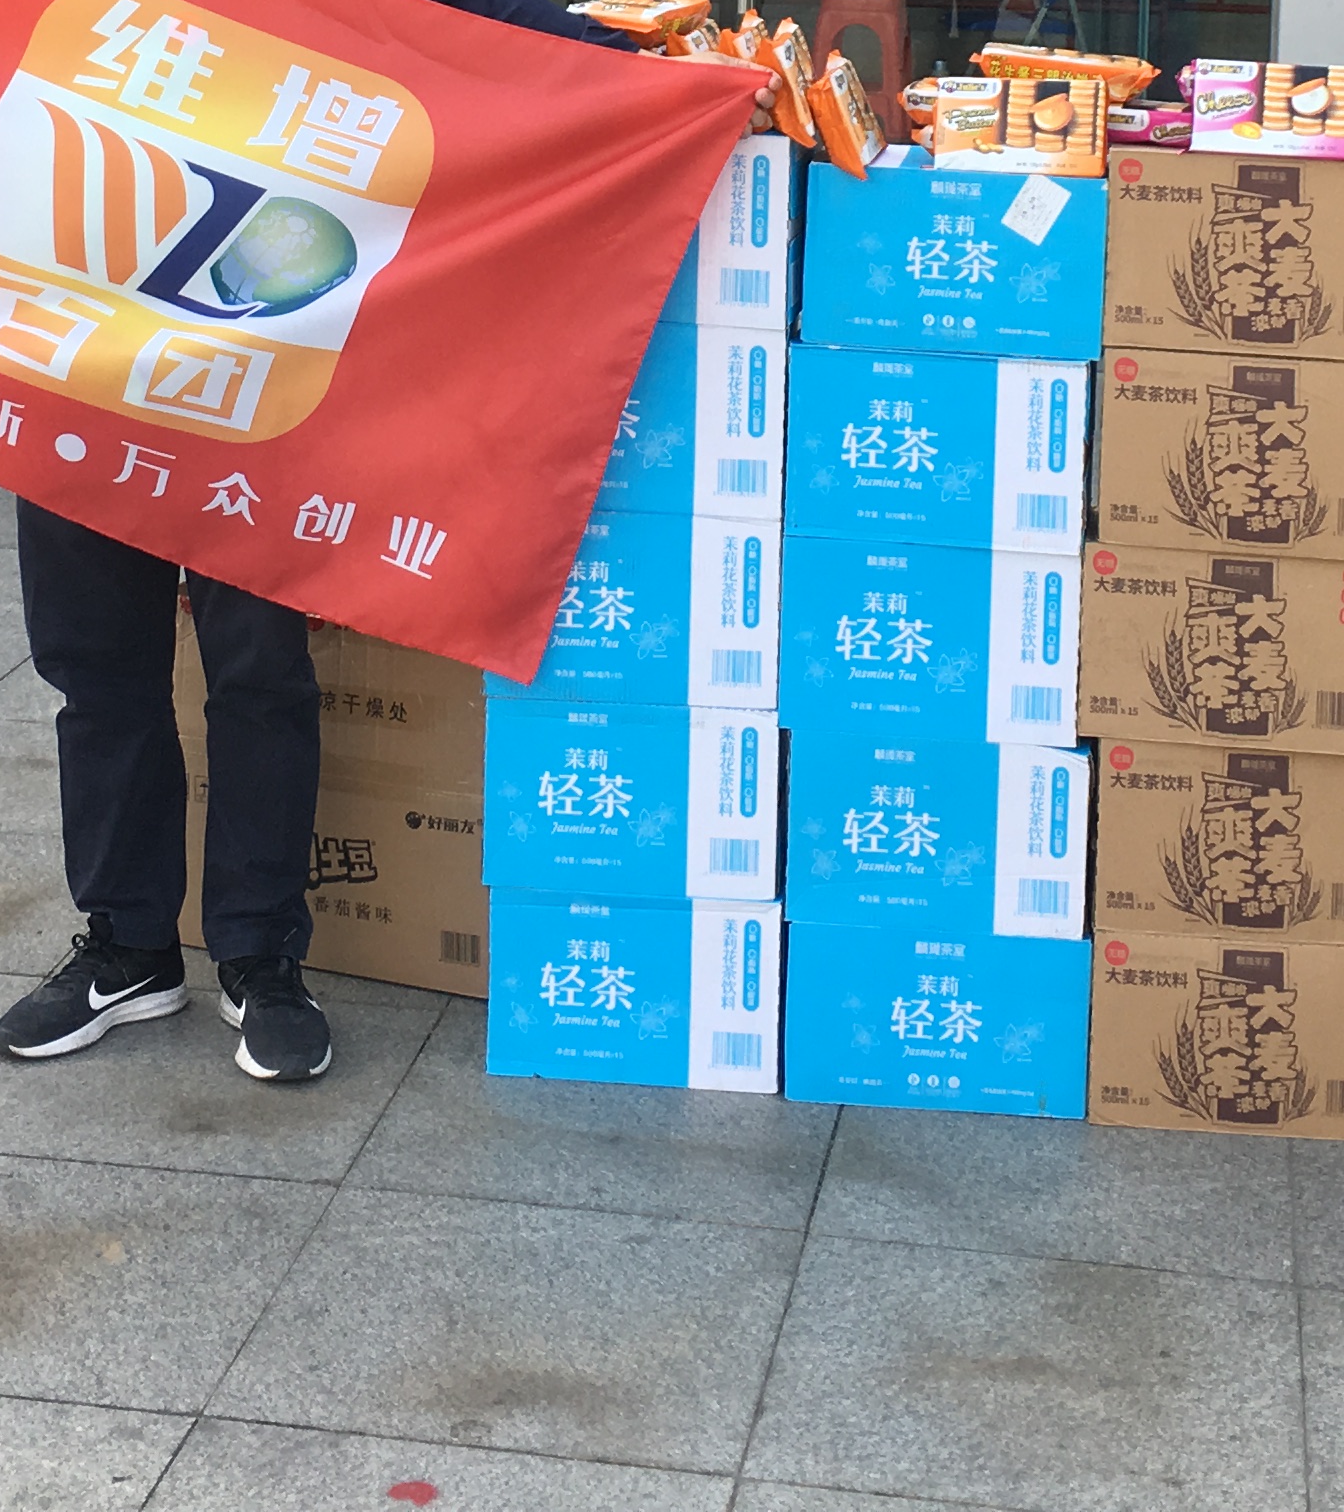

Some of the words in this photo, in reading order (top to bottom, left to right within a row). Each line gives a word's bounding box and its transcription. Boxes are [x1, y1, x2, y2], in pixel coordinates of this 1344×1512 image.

[1196, 89, 1254, 115] Cheese
[728, 153, 747, 248] 茉莉花茶饮料
[1119, 184, 1203, 204] 大麦茶饮料
[932, 214, 975, 236] 茉莉
[906, 236, 998, 283] 轻茶
[725, 345, 743, 438] 茉莉花茶饮料
[1114, 384, 1198, 405] 大麦茶饮料
[868, 399, 913, 423] 茉莉
[1025, 377, 1045, 472] 茉莉花茶饮料
[840, 423, 938, 472] 轻茶
[567, 561, 609, 583] 茉莉
[720, 536, 738, 628] 茉莉花茶饮料
[1094, 576, 1177, 597] 大麦茶饮料
[862, 591, 908, 614] 茉莉
[1019, 570, 1038, 664] 茉莉花茶饮料
[835, 614, 933, 665] 轻茶
[564, 748, 607, 771] 茉莉
[718, 726, 736, 817] 茉莉花茶饮料
[538, 772, 634, 819] 轻茶
[1110, 771, 1194, 792] 大麦茶饮料
[869, 785, 914, 808] 茉莉
[427, 815, 475, 834] 好丽友
[1026, 765, 1046, 857] 茉莉花茶饮料
[842, 808, 941, 858] 轻茶
[313, 896, 393, 924] 番茄酱味
[566, 939, 610, 962] 茉莉
[719, 918, 738, 1010] 茉莉花茶饮料
[539, 963, 636, 1010] 轻茶
[916, 974, 959, 997] 茉莉
[1105, 968, 1188, 989] 大麦茶饮料
[890, 995, 983, 1043] 轻茶
